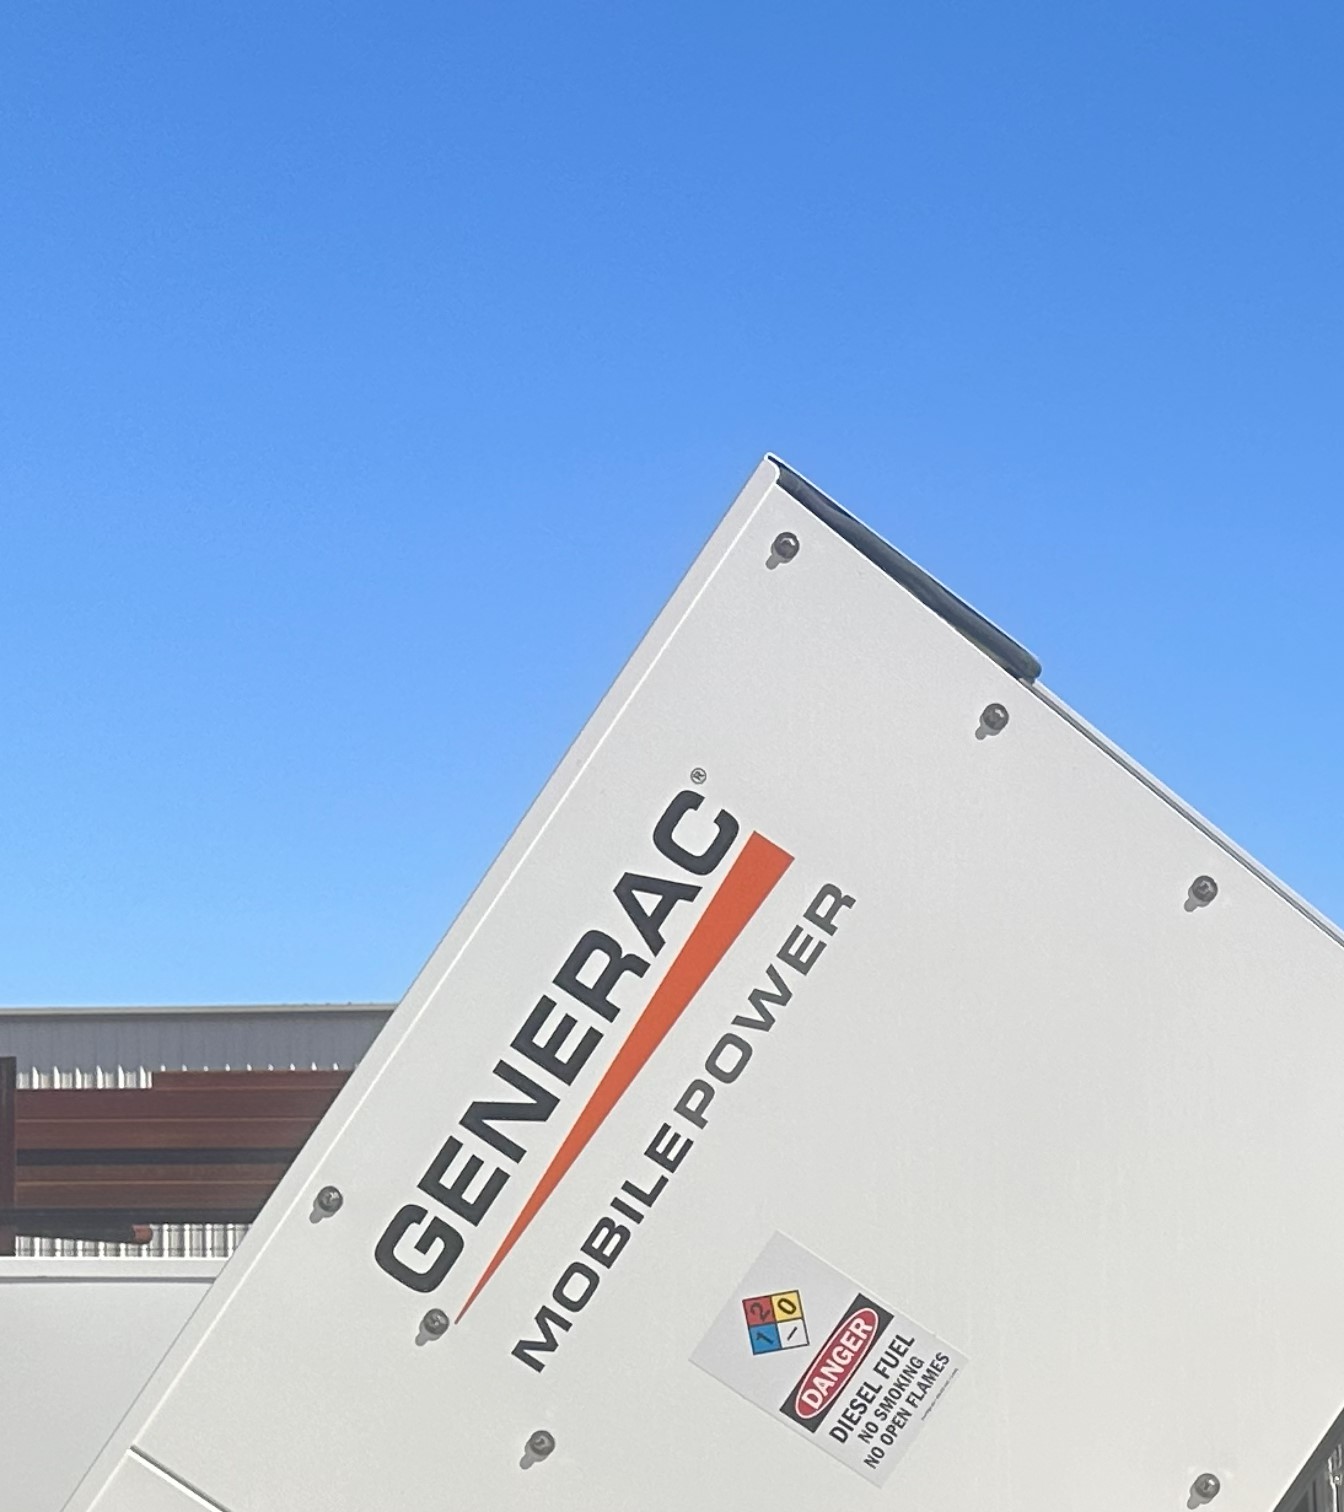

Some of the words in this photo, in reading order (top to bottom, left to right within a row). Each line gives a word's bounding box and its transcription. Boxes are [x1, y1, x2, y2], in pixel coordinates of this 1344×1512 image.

[374, 790, 740, 1292] GENERAC
[750, 1302, 770, 1321] 2
[756, 1332, 775, 1345] 1
[777, 1297, 797, 1315] 0
[800, 1316, 873, 1410] DANGER
[829, 1381, 882, 1444] DIESEL
[872, 1333, 915, 1379] FUEL
[857, 1422, 879, 1444] NO
[874, 1356, 925, 1421] SMOKING
[863, 1446, 885, 1469] NO
[880, 1407, 912, 1445] OPEN
[908, 1352, 950, 1409] FLAMES
